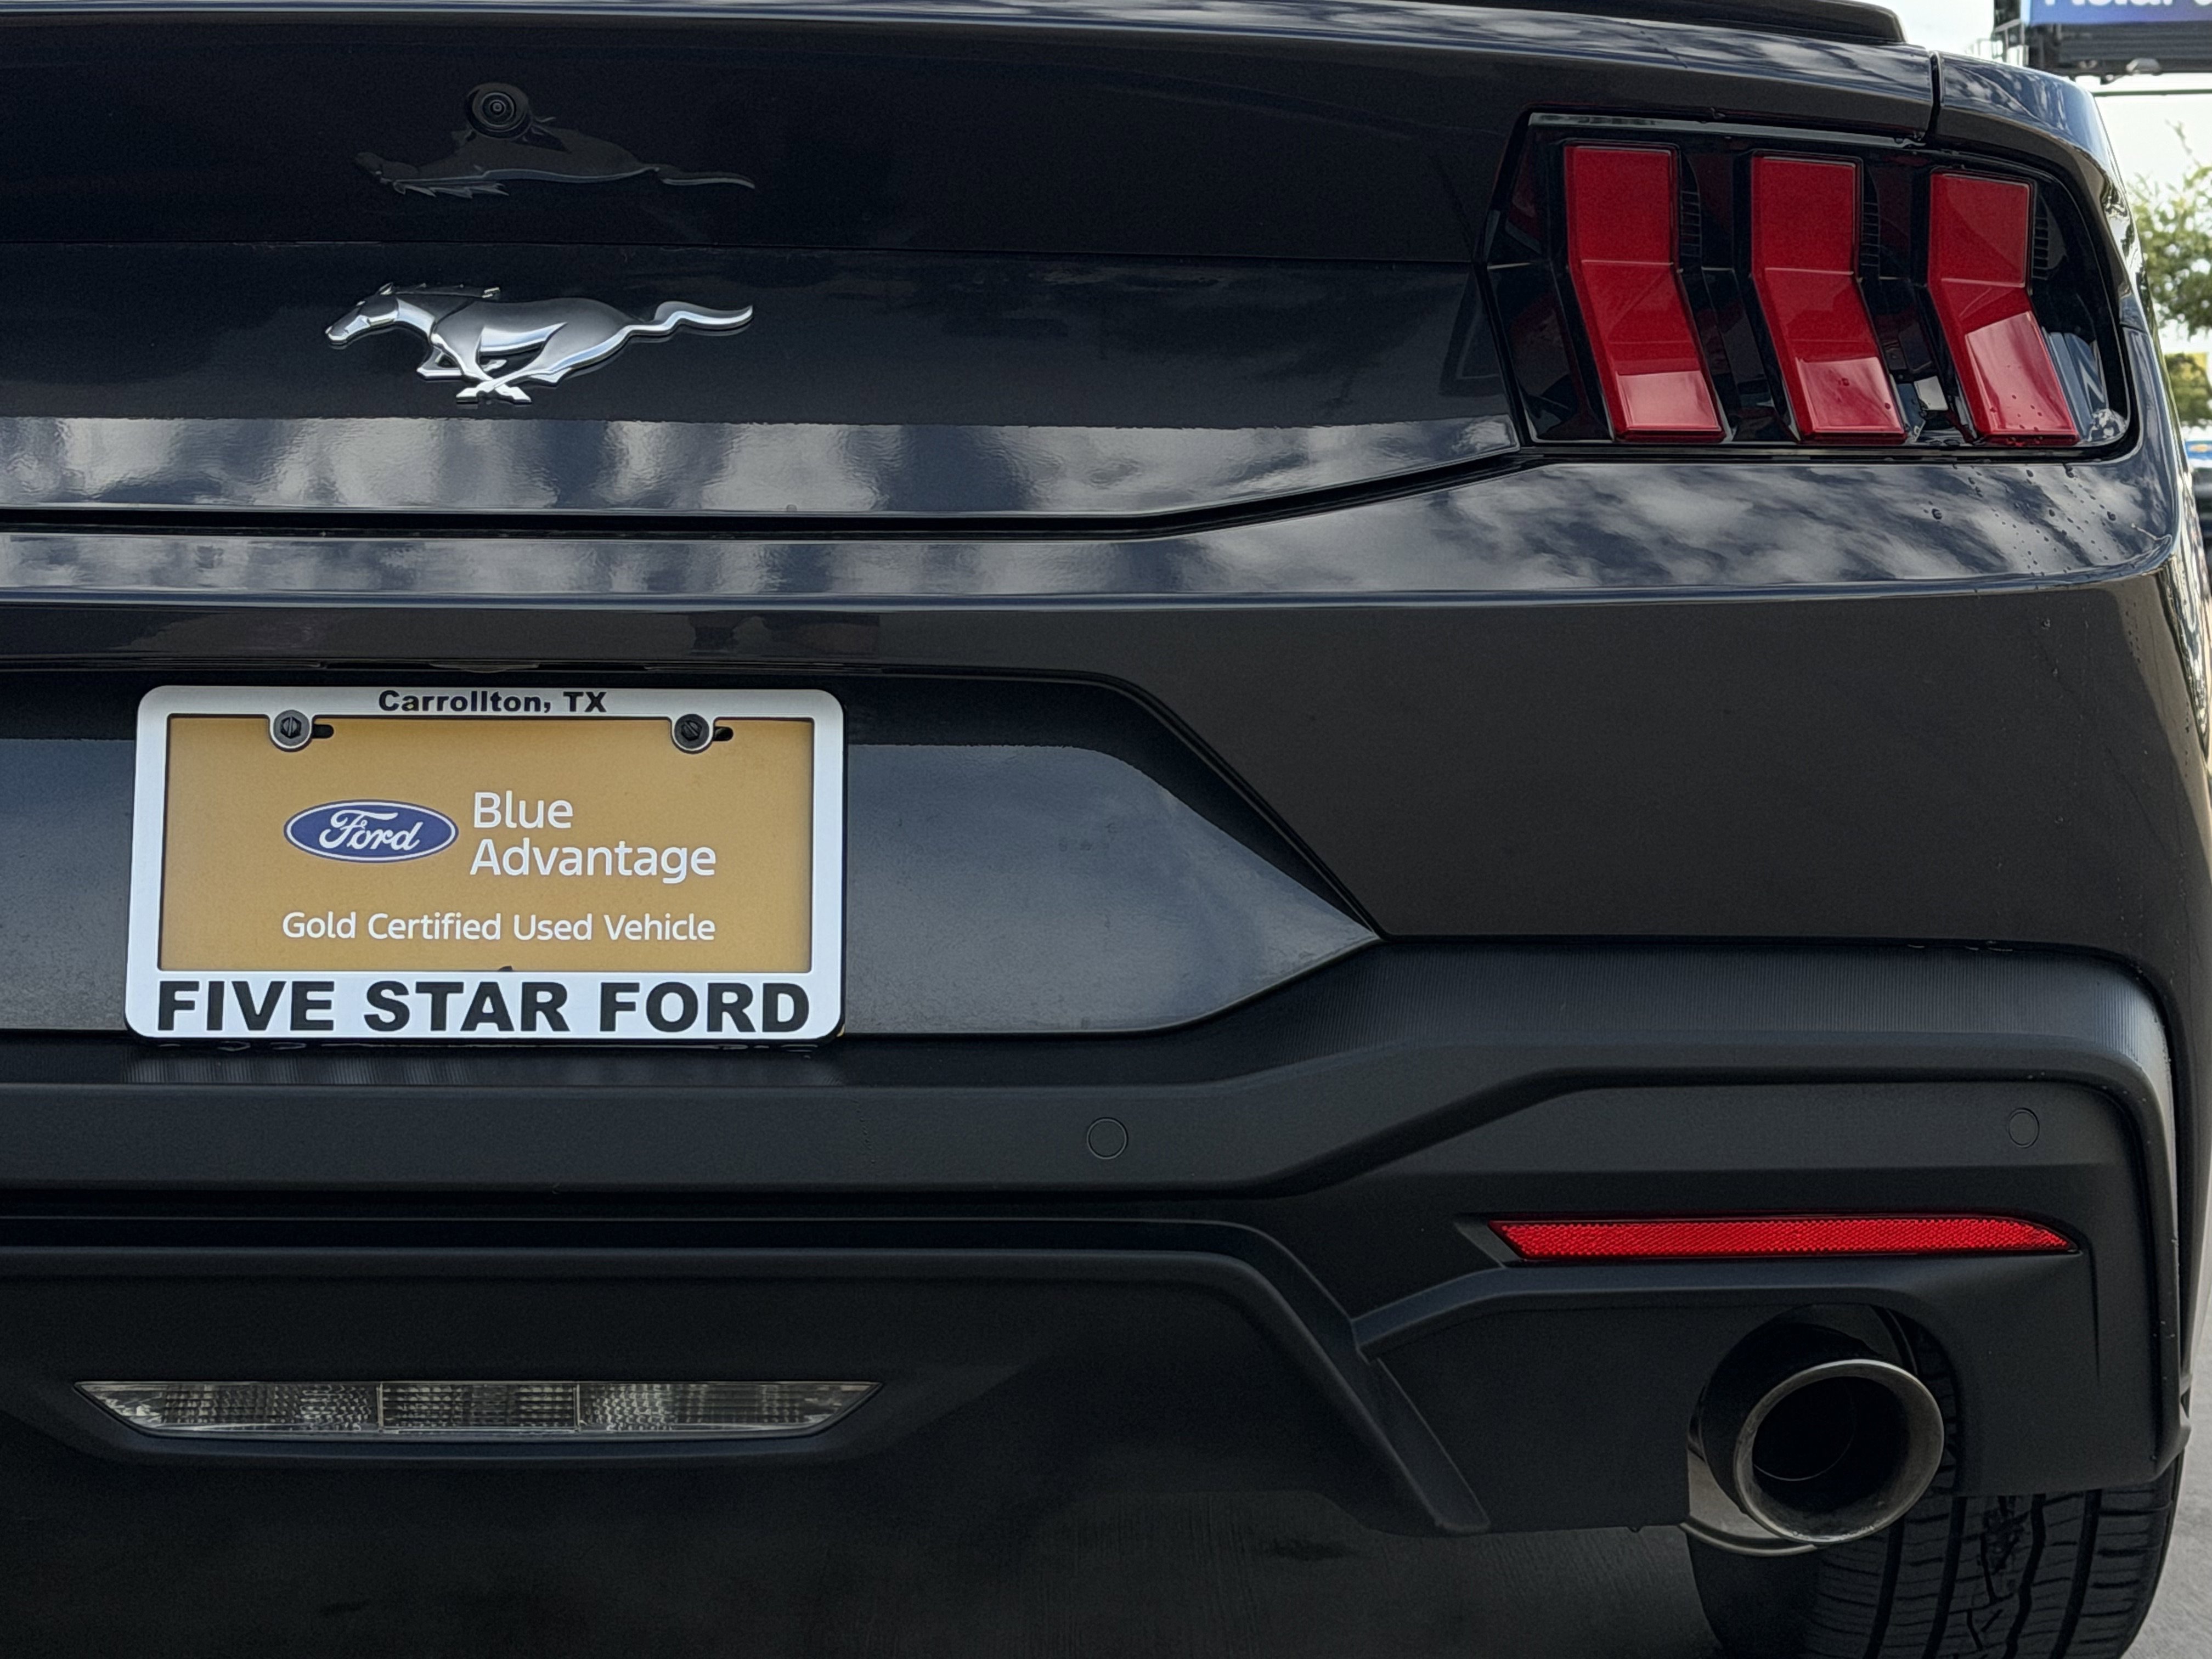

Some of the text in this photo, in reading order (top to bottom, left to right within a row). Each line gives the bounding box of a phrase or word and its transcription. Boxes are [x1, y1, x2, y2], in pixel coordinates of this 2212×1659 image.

[379, 689, 607, 714] Carrollton, TX
[473, 790, 573, 828] Blue
[319, 809, 424, 851] Ford
[470, 837, 716, 884] Advantage
[283, 911, 716, 940] Gold Certified Used Vehicle
[157, 980, 809, 1032] FIVE STAR FORD
